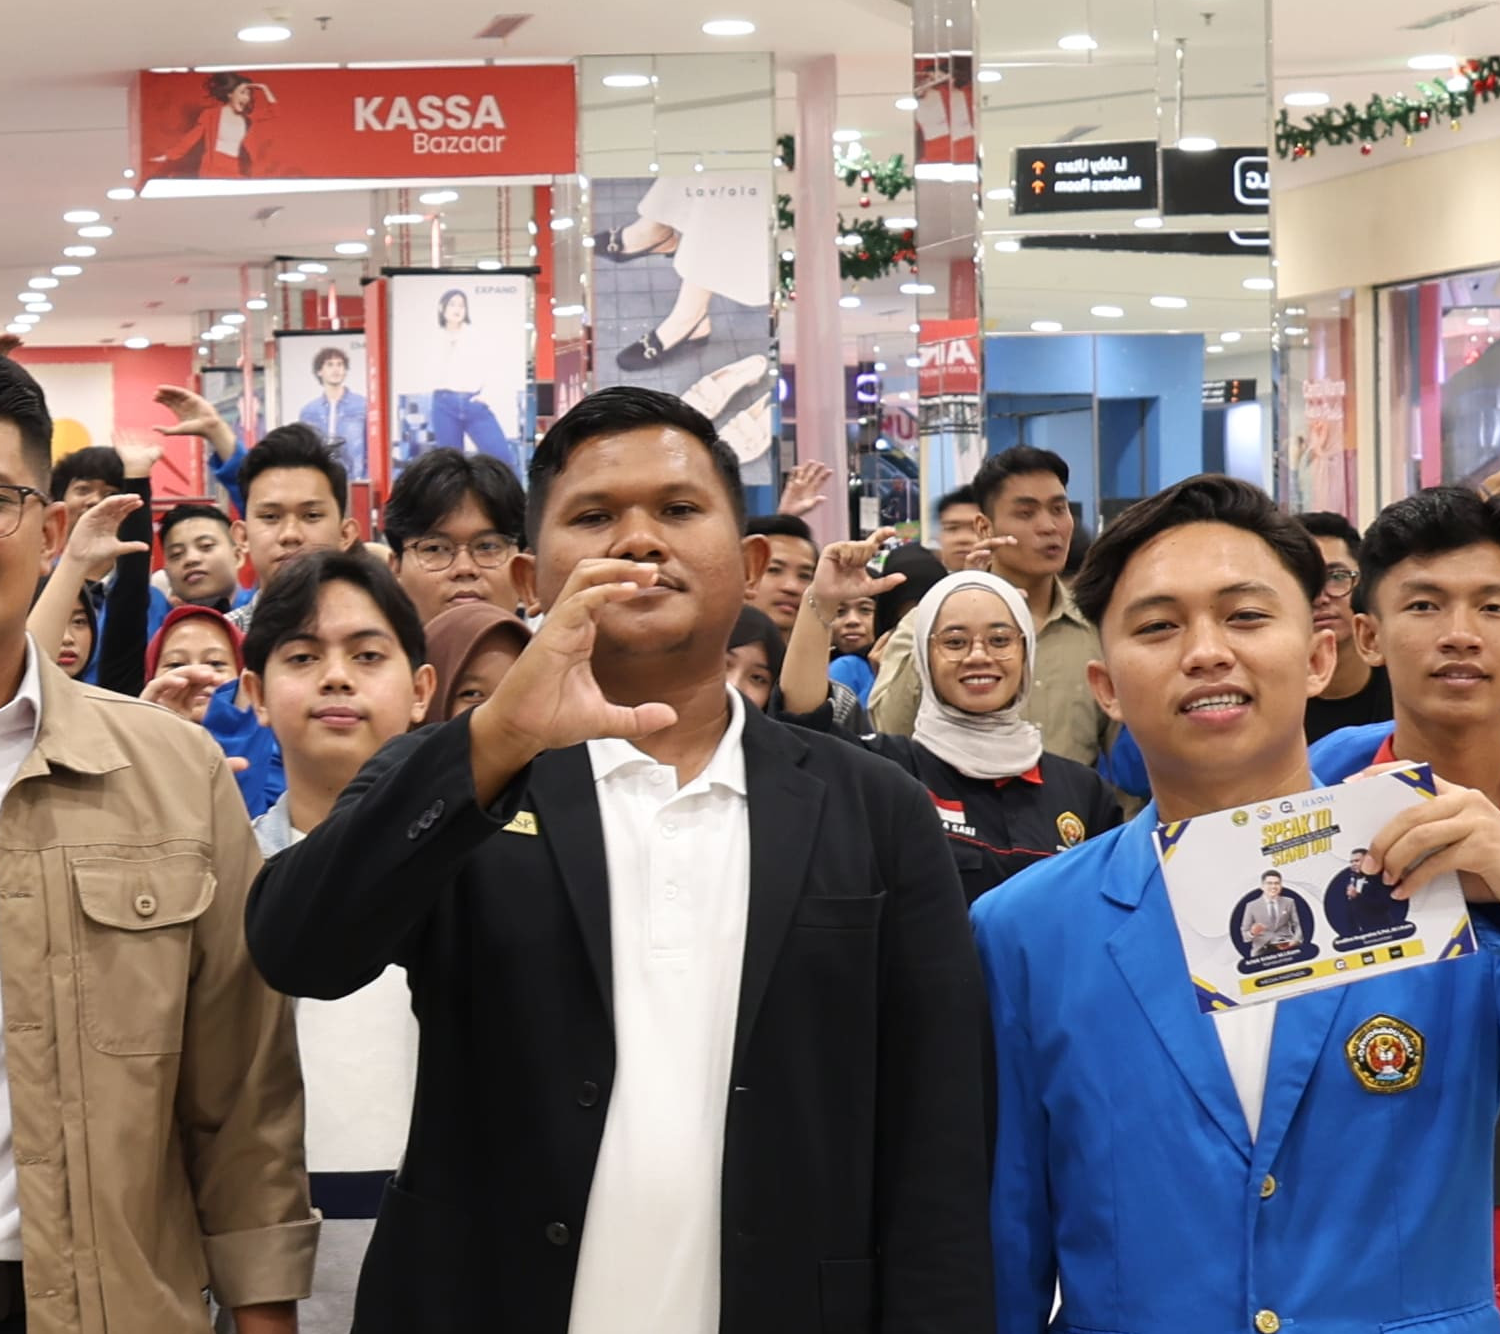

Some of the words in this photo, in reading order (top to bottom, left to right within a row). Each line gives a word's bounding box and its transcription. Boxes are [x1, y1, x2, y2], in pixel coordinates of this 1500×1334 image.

[354, 95, 506, 131] KASSA
[413, 132, 506, 154] Bazaar
[1262, 813, 1311, 846] SPEAK
